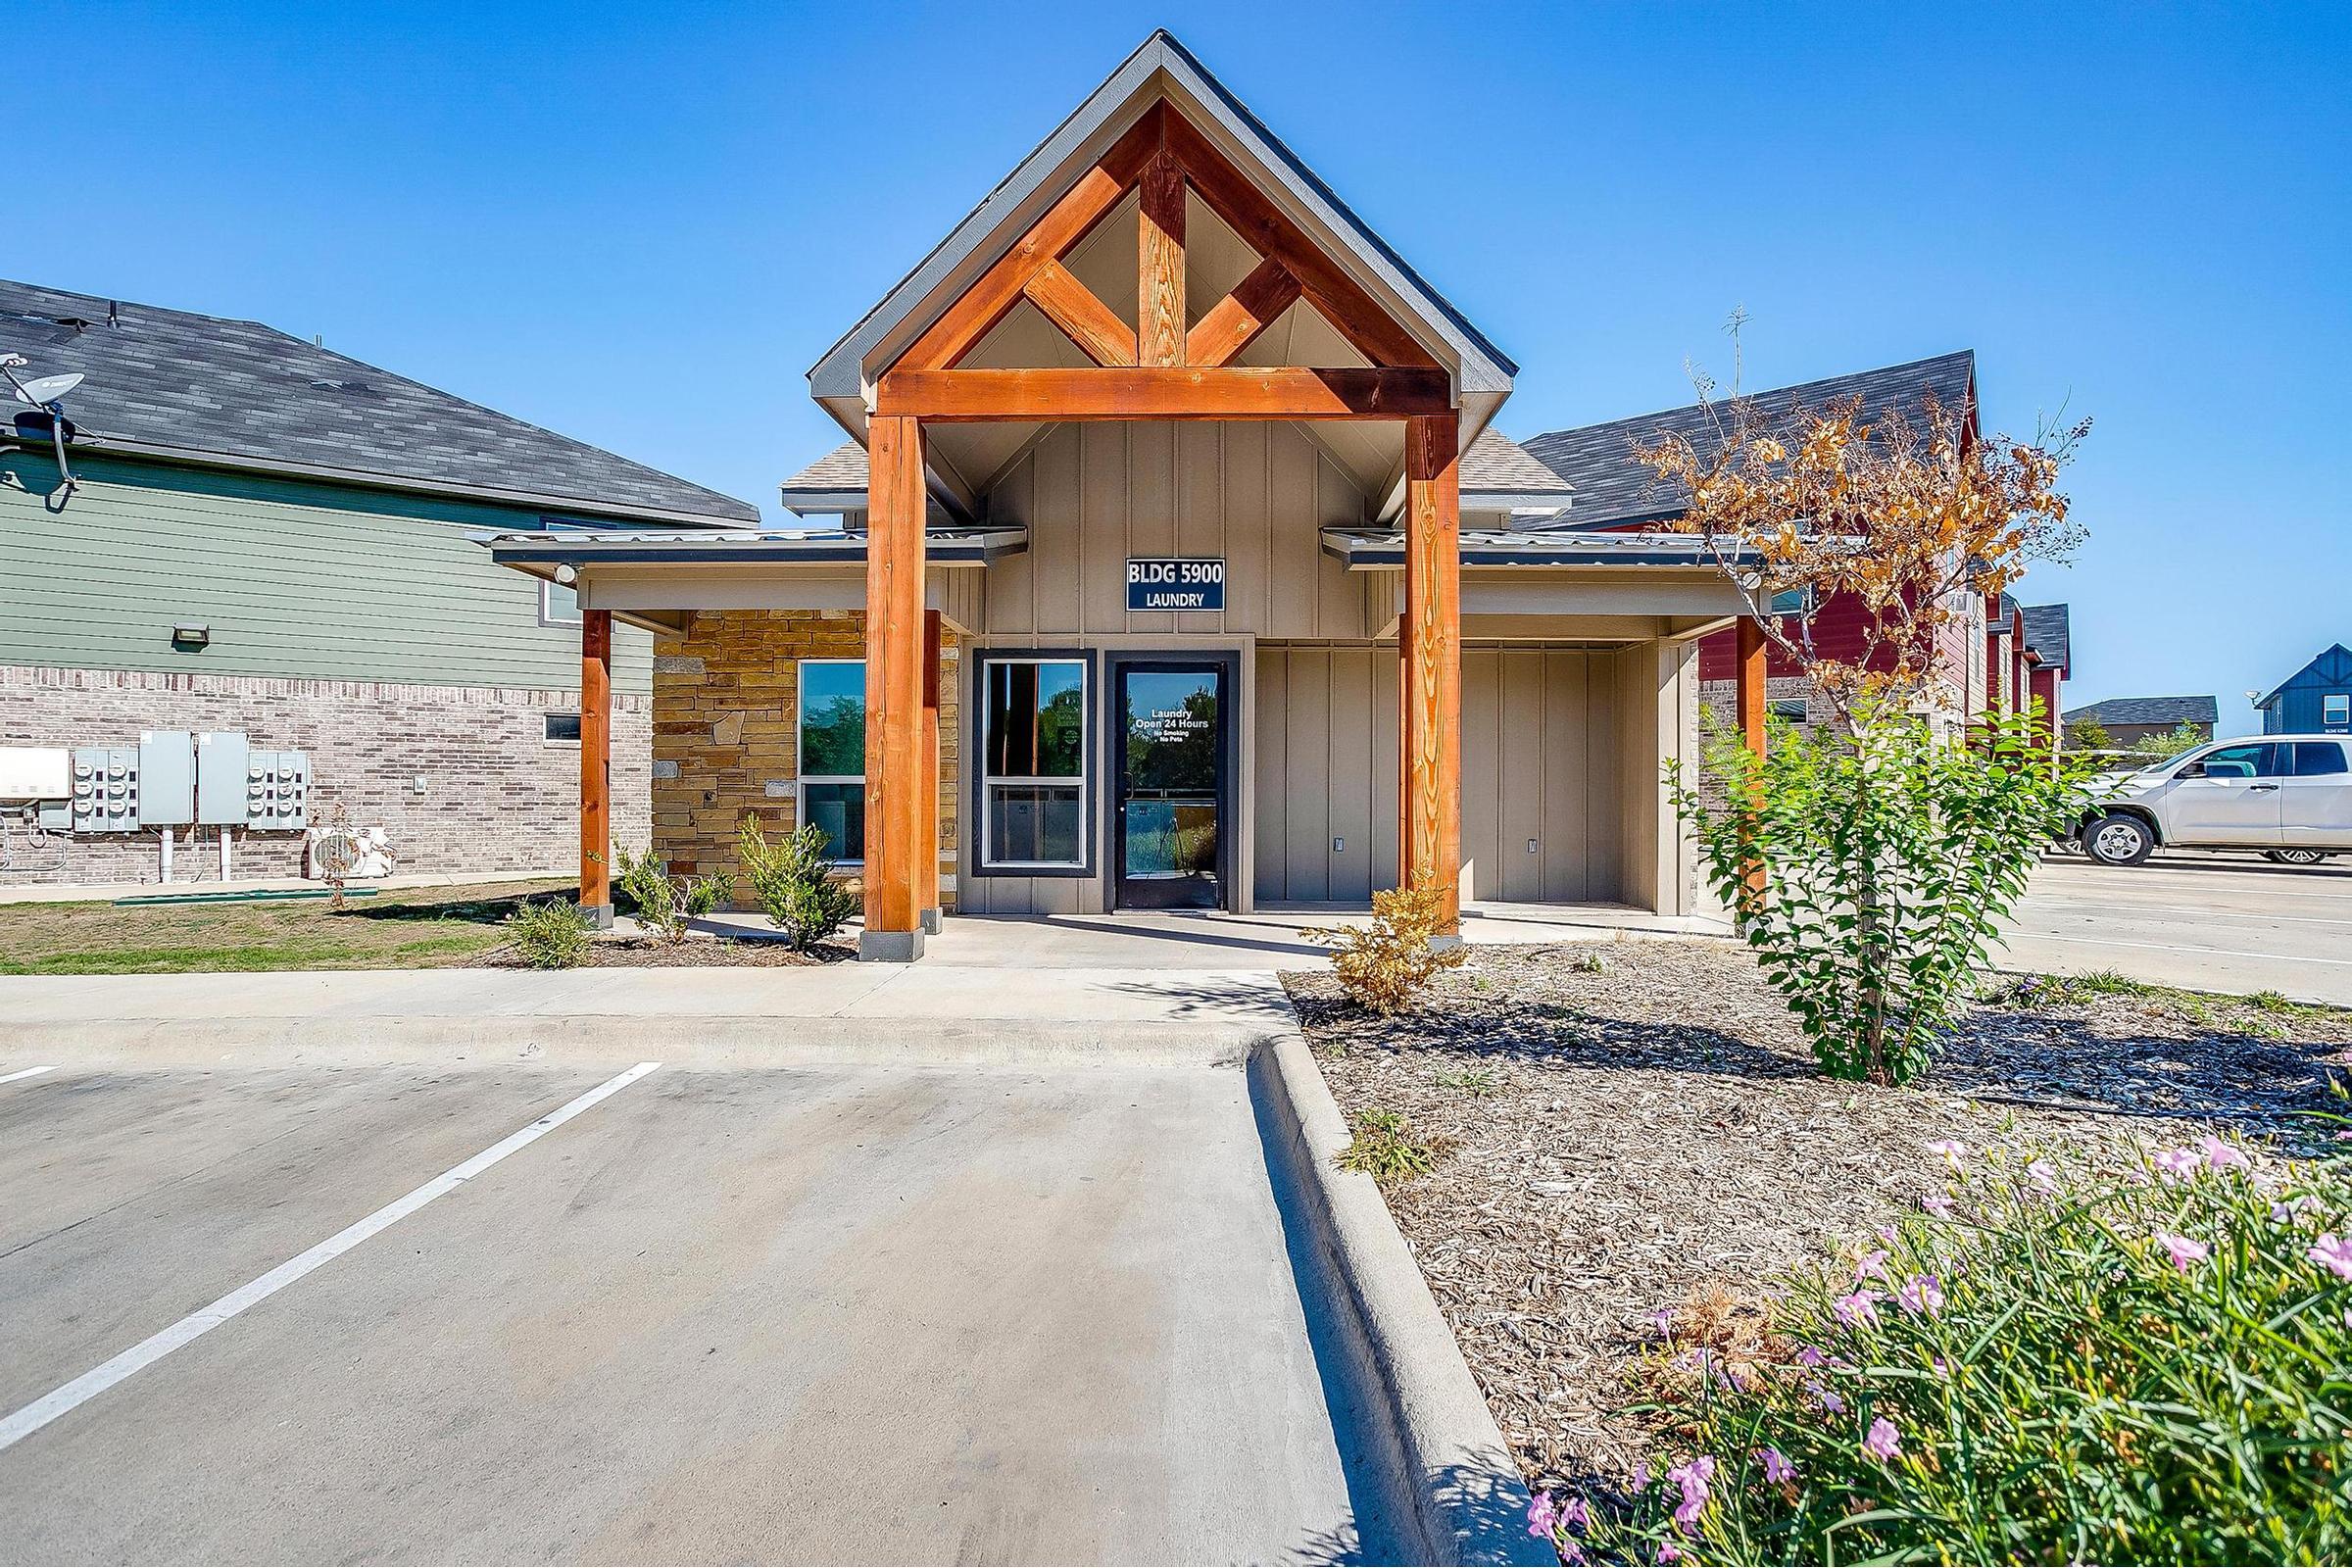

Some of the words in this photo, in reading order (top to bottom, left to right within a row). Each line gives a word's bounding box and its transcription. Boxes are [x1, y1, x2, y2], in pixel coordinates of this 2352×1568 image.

[1129, 564, 1176, 583] BLDG
[1181, 564, 1223, 583] 5900
[1147, 593, 1204, 607] LAUNDRY
[1152, 709, 1193, 720] Laundry
[1136, 718, 1162, 729] Open
[1164, 718, 1176, 728] 24
[1178, 718, 1208, 728] Hours
